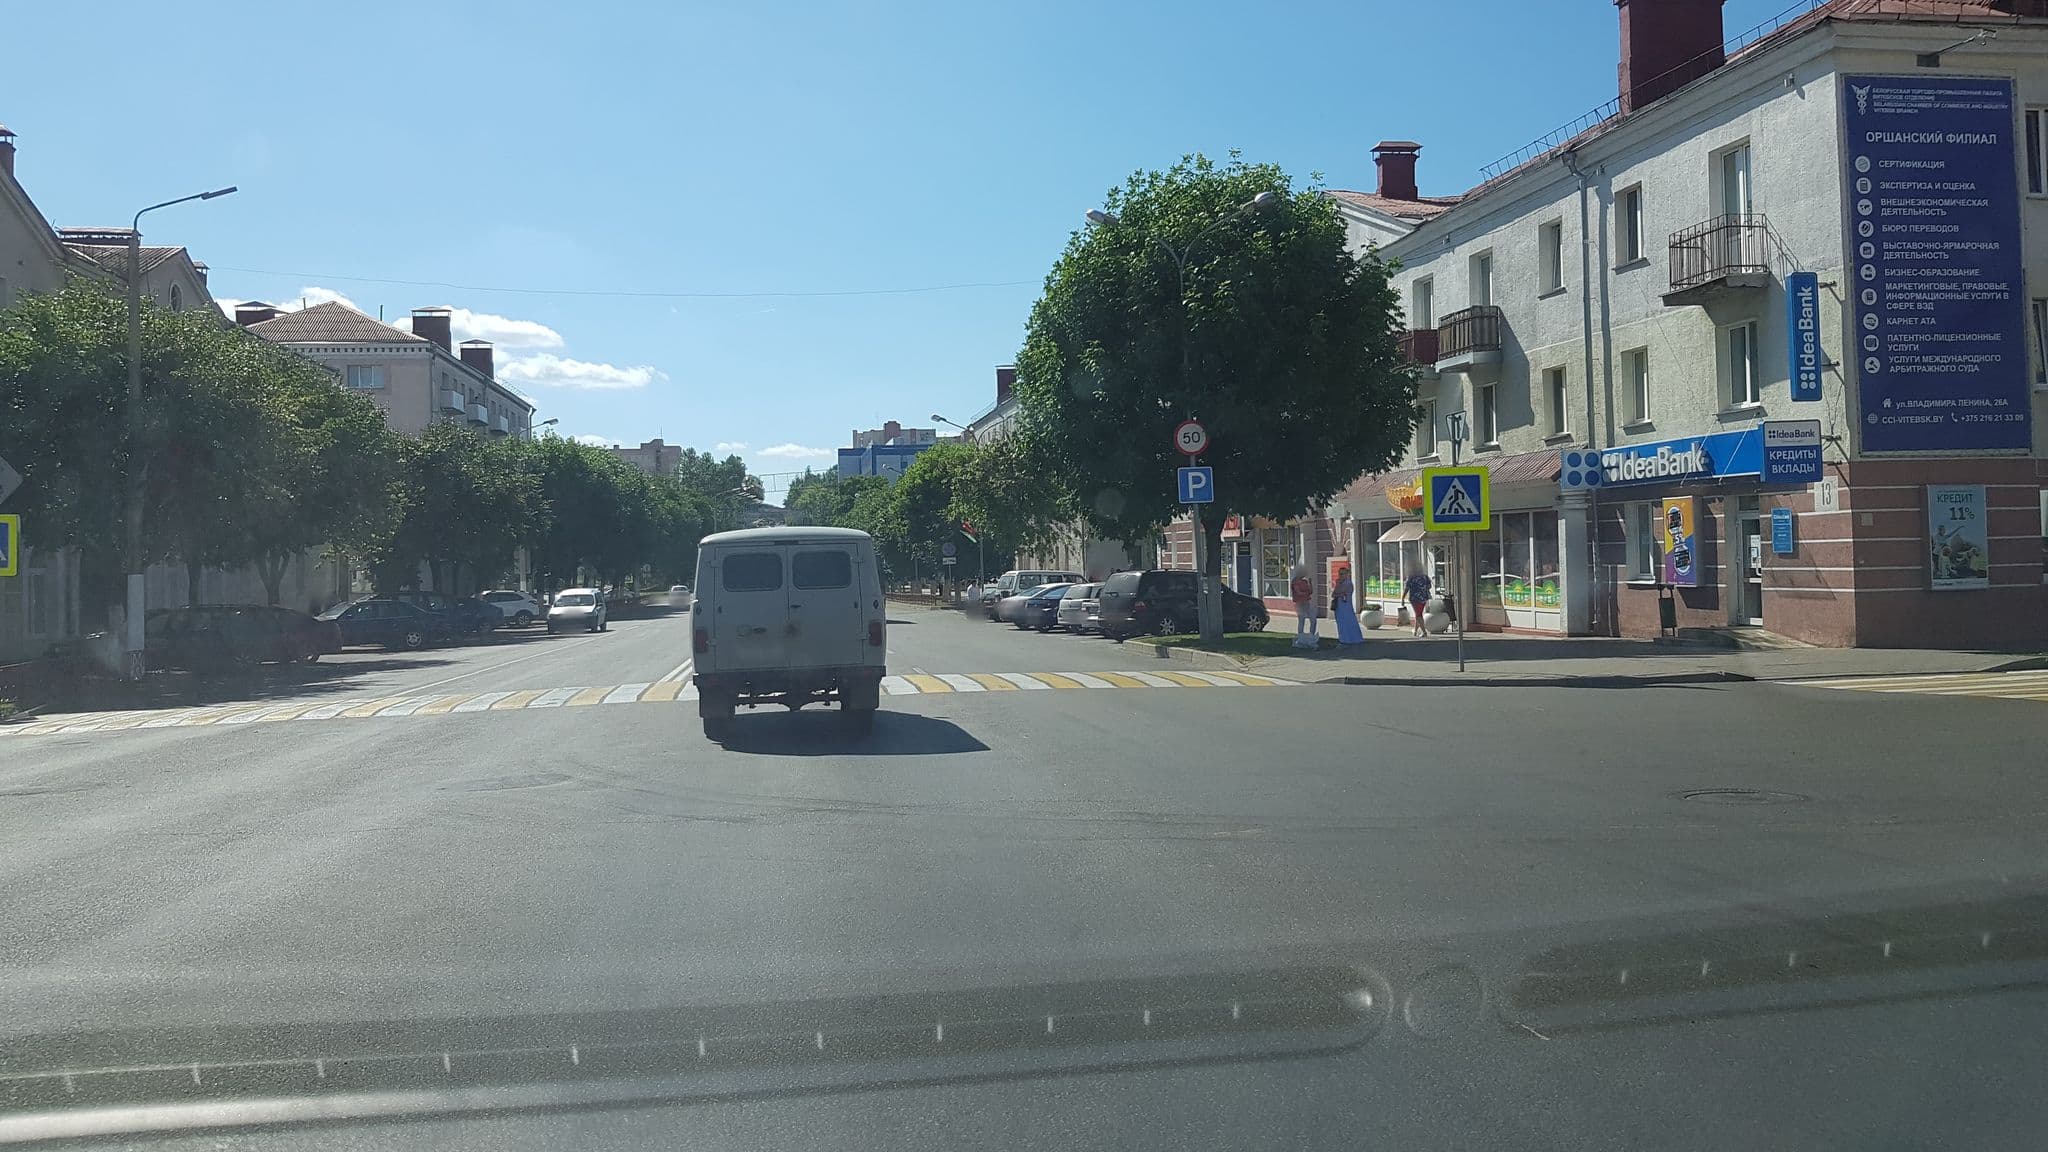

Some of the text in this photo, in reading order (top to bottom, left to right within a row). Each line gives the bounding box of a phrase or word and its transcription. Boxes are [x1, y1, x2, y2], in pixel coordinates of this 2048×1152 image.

[1865, 130, 1997, 145] ОРШАНСКИЙ ФИЛИАЛ
[1878, 160, 1945, 169] СЕРТИФИКАЦИЯ
[1879, 181, 1976, 191] ЭКСПЕРТИЗА И ОЦЕНКА
[1880, 198, 1989, 207] ВНЕШНЕЭКОНОМИЧЕСКАЯ
[1880, 207, 1947, 217] ДЕЯТЕЛЬНОСТЬ
[1881, 224, 1960, 233] БЮРО ПЕРЕВОДОВ
[1883, 241, 2000, 250] ВЫСТАВОЧНО-ЯРМАРОЧНАЯ
[1883, 251, 1949, 260] ДЕЯТЕЛЬНОСТЬ
[1884, 268, 1980, 277] БИЗНЕС-ОБРАЗОВАНИЕ
[1885, 282, 1961, 291] МАРКЕТИНГОВЫЕ,
[1885, 292, 2009, 300] ИНФОРМАЦИОННЫЕ УСЛУГИ В
[1886, 302, 1934, 311] СФЕРЕ ВЭД
[1886, 317, 1936, 325] КАРНЕТ АТА
[1887, 333, 2001, 342] ПАТЕНТНО-ЛИЦЕНЗИОННЫЕ
[1887, 344, 1919, 352] УСЛУГИ
[1888, 354, 2001, 364] УСЛУГИ МЕЖДУНАРОДНОГО
[1889, 364, 1980, 373] АРБИТРАЖНОГО СУДА
[1183, 431, 1201, 444] 50
[1769, 449, 1817, 461] КРЕДИТЫ
[1771, 463, 1816, 474] ВКЛАДЫ
[1188, 471, 1206, 499] P
[1821, 483, 1832, 505] 13
[1936, 493, 1974, 504] КРЕДИТ
[1949, 506, 1975, 521] 11%
